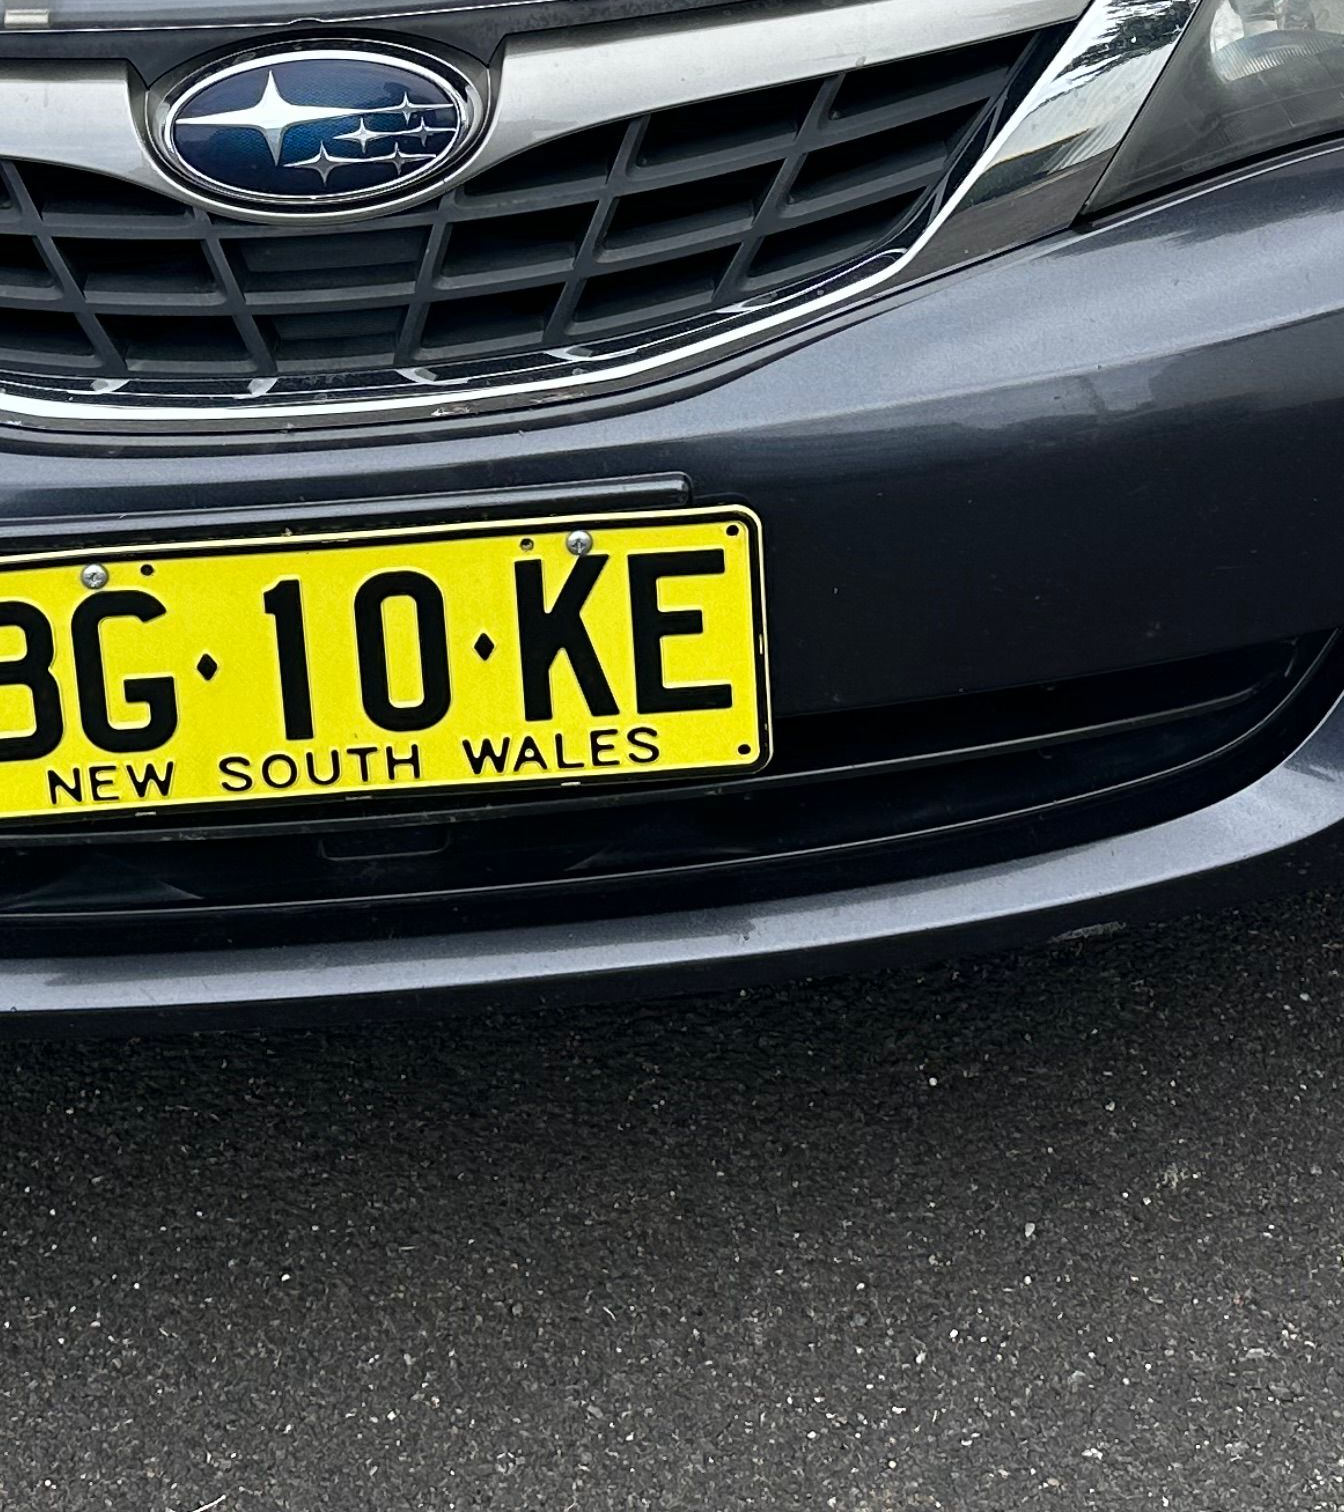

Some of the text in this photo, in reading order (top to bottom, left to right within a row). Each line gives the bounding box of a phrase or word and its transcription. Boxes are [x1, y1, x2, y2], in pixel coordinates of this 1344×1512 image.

[47, 727, 660, 805] NEW SOUTH WALES
